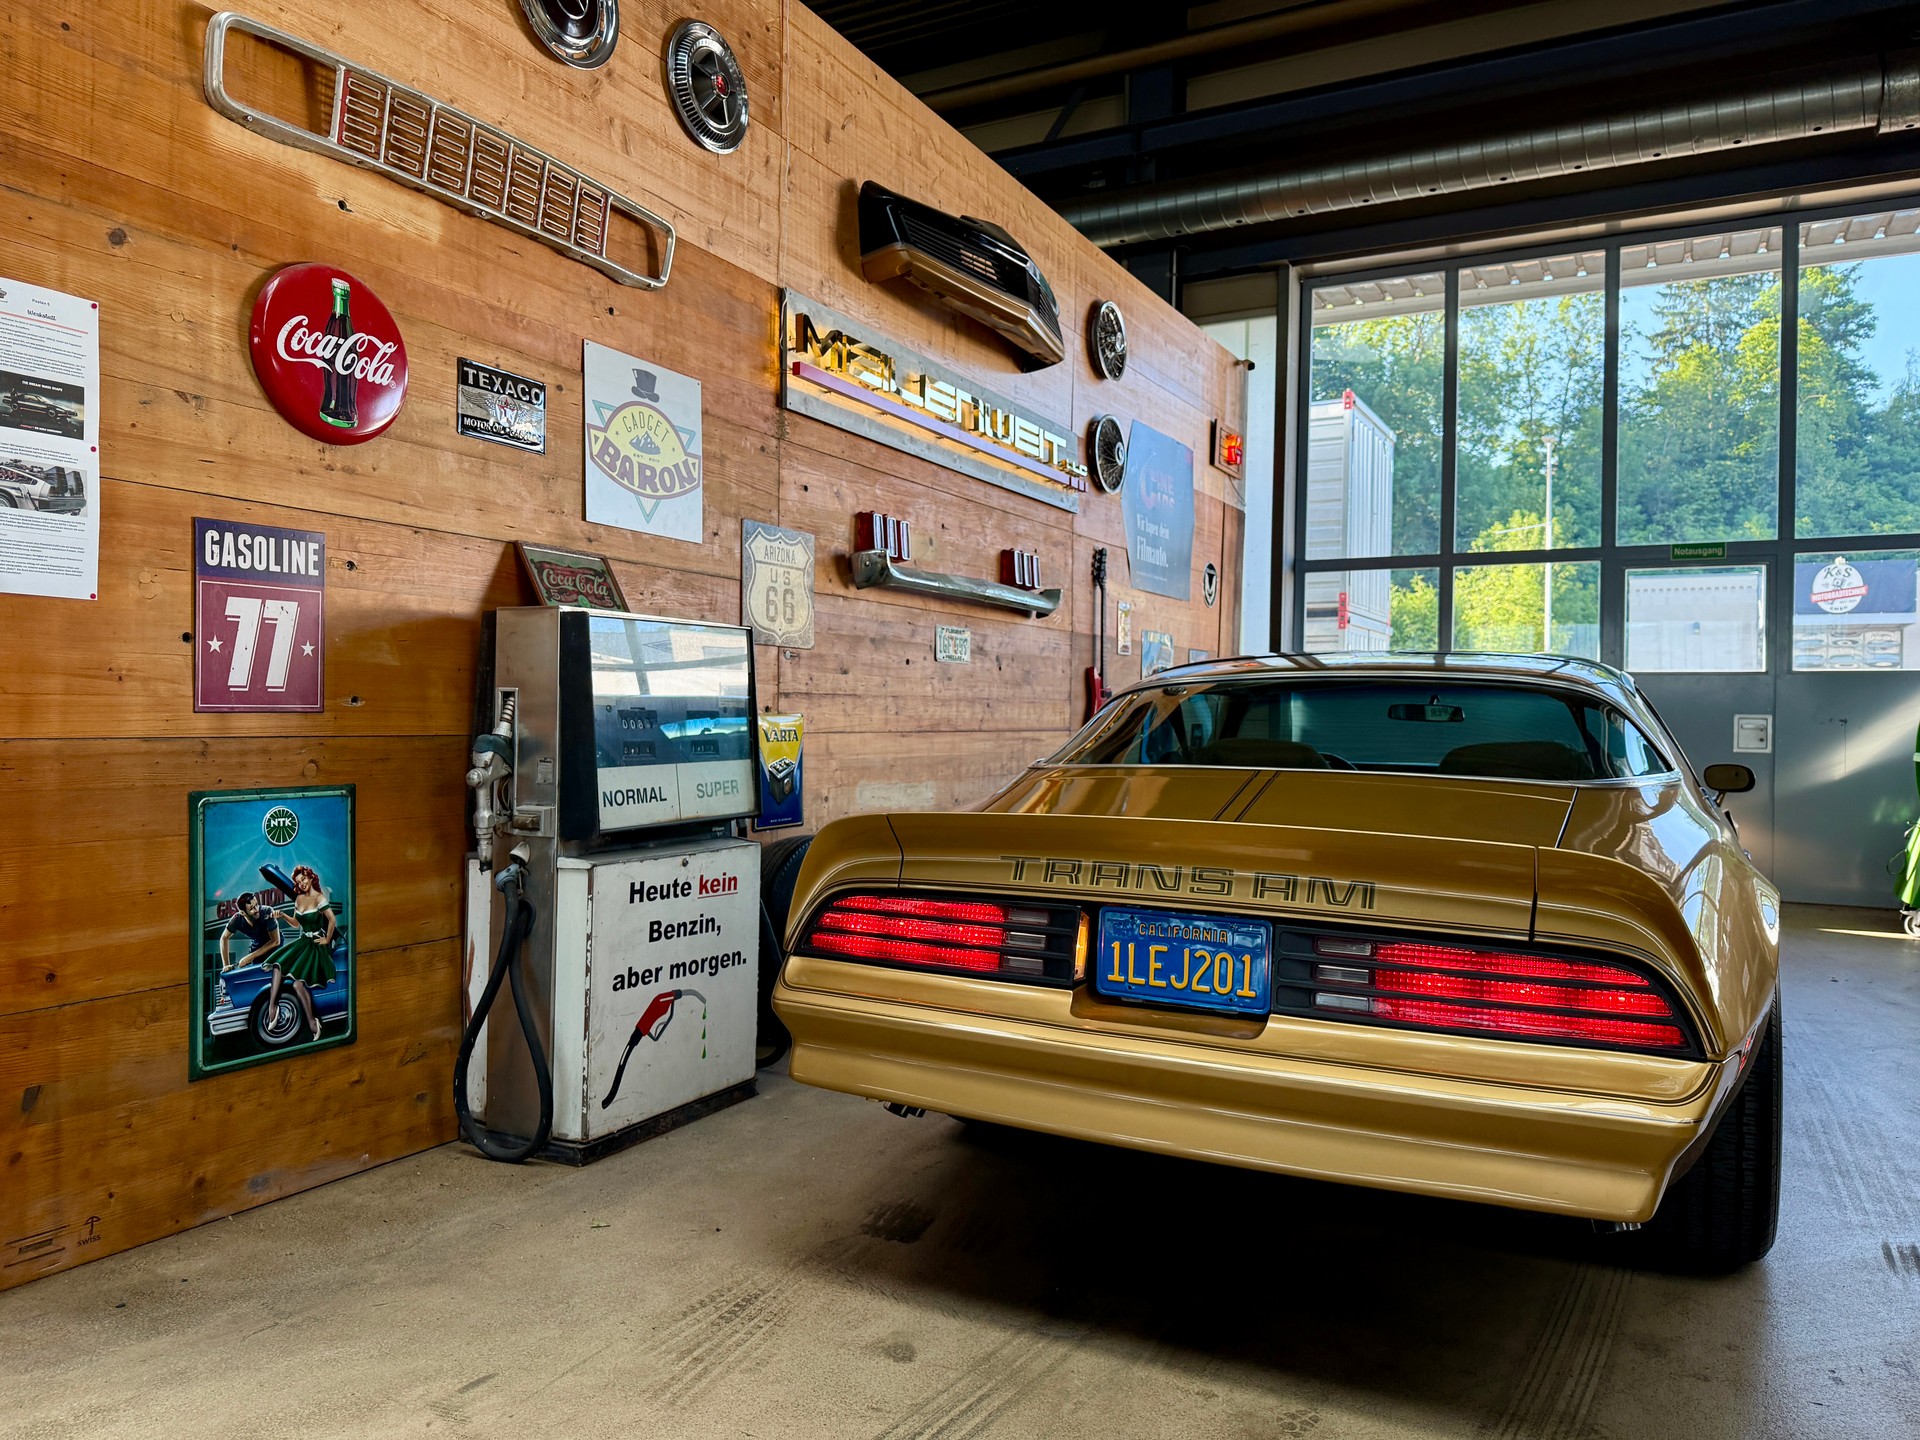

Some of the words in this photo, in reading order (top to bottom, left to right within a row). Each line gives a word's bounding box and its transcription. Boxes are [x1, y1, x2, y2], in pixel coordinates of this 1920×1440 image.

[463, 366, 543, 406] TEXACO
[622, 410, 670, 443] GADGET
[595, 434, 697, 494] BARON
[205, 529, 320, 577] GASOLINE
[764, 545, 797, 565] ARIZONA
[1674, 547, 1723, 557] Notausgang
[765, 585, 795, 625] 66
[225, 597, 300, 692] 77
[762, 727, 799, 742] VARTA
[602, 786, 667, 808] NORMAL
[696, 779, 739, 799] SUPER
[270, 817, 292, 828] NTK
[629, 878, 692, 904] Heute
[698, 872, 738, 897] kein
[1000, 855, 1235, 896] TRANS
[1252, 871, 1377, 910] AM
[649, 914, 721, 943] Benzin,
[1139, 923, 1228, 944] CALIFORNIA
[612, 966, 663, 992] aber
[669, 950, 747, 979] morgen.
[1107, 940, 1257, 998] 1LEJ201
